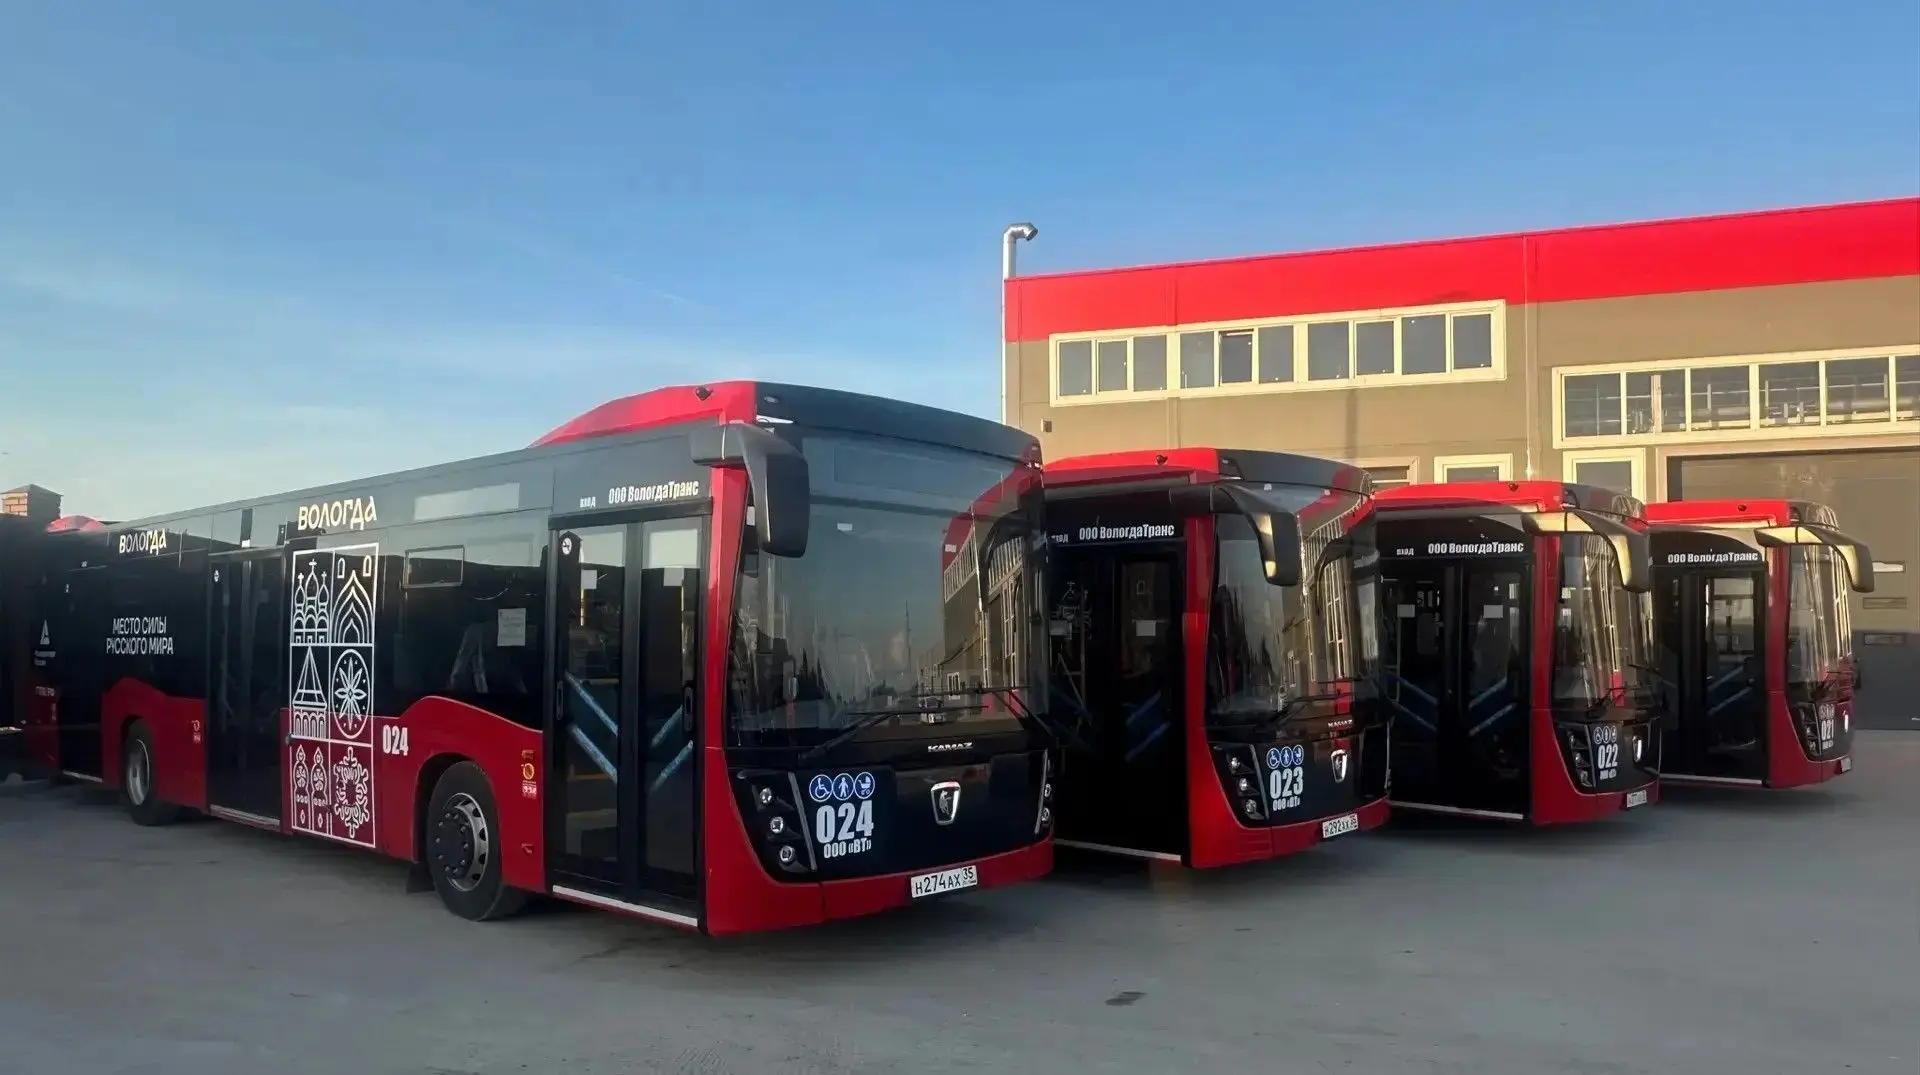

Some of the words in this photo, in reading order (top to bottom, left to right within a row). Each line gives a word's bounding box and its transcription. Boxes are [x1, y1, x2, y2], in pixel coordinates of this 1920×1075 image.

[608, 487, 627, 504] ООО
[627, 481, 699, 502] ВологдаТранс
[1079, 527, 1098, 540] ООО
[1100, 524, 1175, 539] ВологдаТранс
[1428, 543, 1447, 554] ООО
[1448, 541, 1524, 554] ВологдаТранс
[1687, 552, 1758, 563] ВологдаТранс
[112, 618, 141, 635] МЕСТО
[141, 616, 167, 635] СИЛЫ
[106, 637, 147, 655] РУССКОГО
[148, 637, 174, 655] МИРА
[1821, 719, 1834, 740] 021
[382, 724, 409, 756] 024
[927, 742, 973, 753] KAMAZ
[1598, 744, 1618, 769] 022
[1270, 766, 1303, 799] 023
[816, 800, 874, 844] 024
[823, 841, 847, 858] ООО
